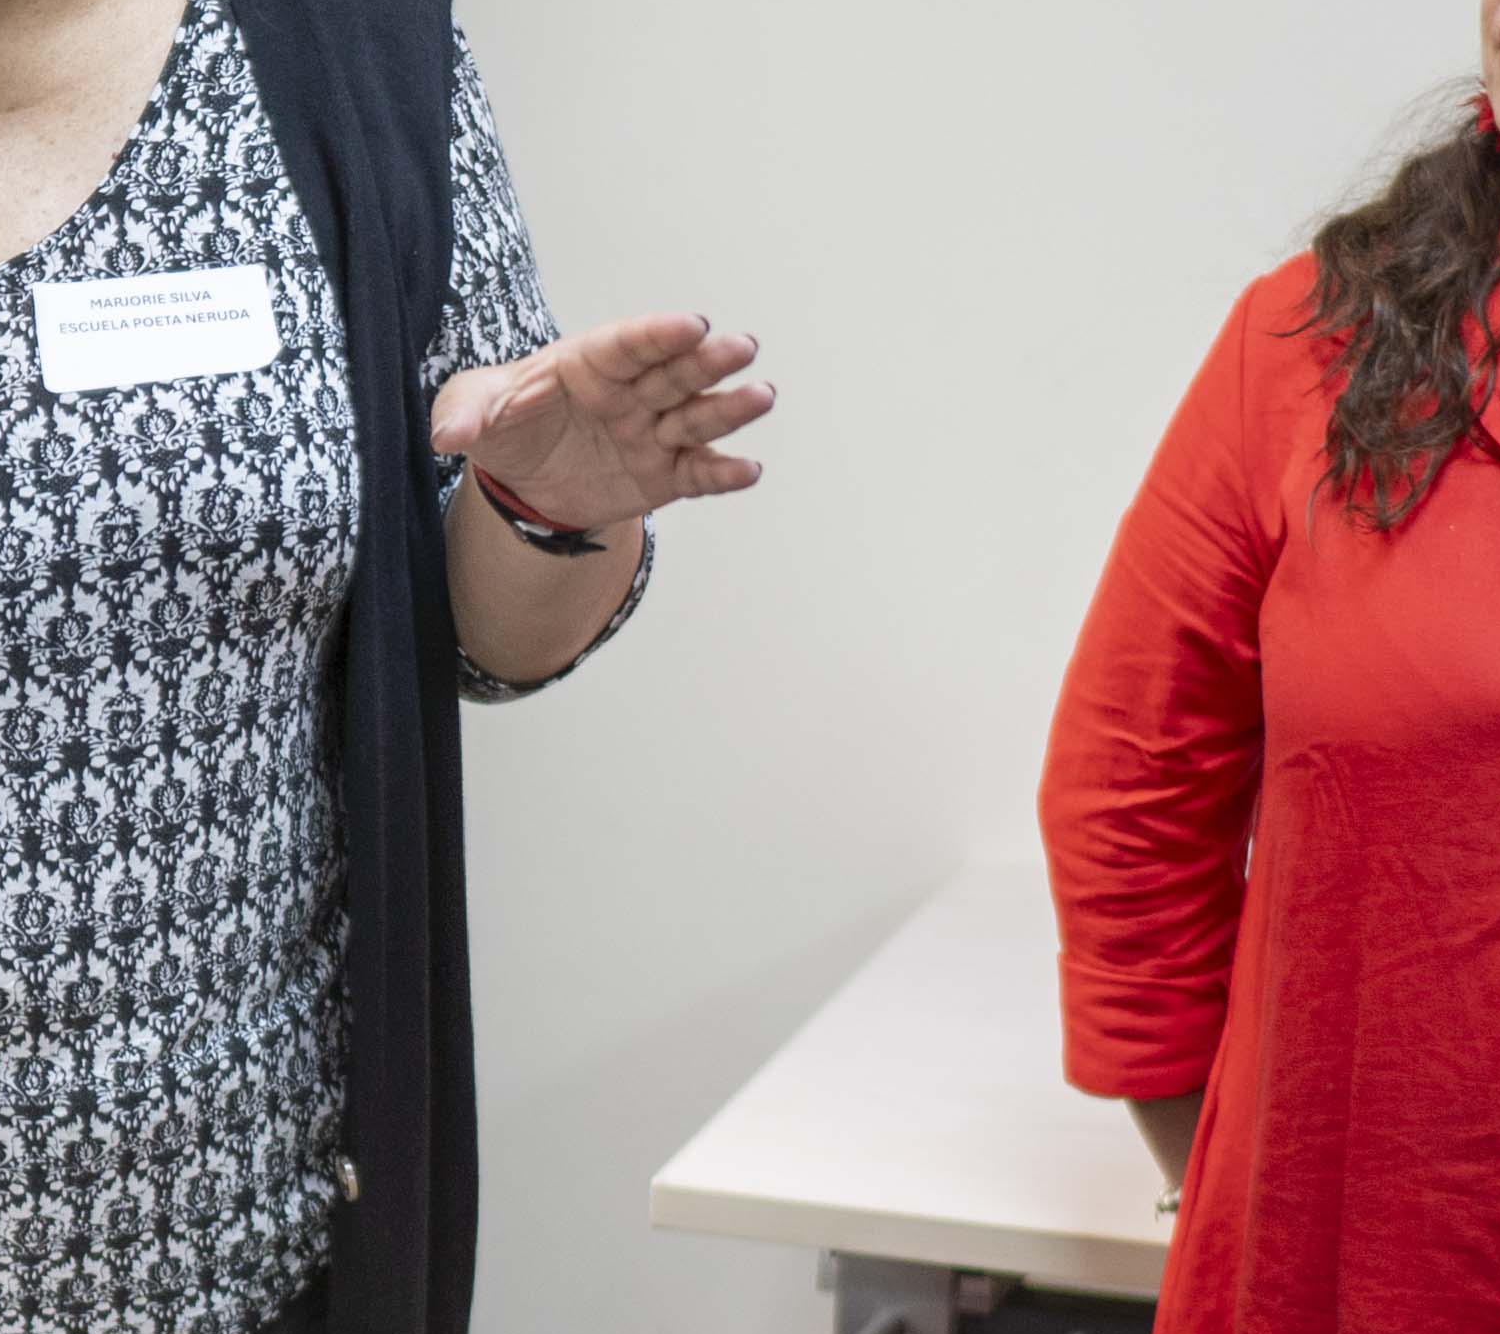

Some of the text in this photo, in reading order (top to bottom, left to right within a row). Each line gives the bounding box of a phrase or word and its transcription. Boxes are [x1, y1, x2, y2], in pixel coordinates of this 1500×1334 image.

[90, 289, 212, 309] MARJORIE SILVA
[59, 308, 250, 335] ESCUELA POETA NERUDA
